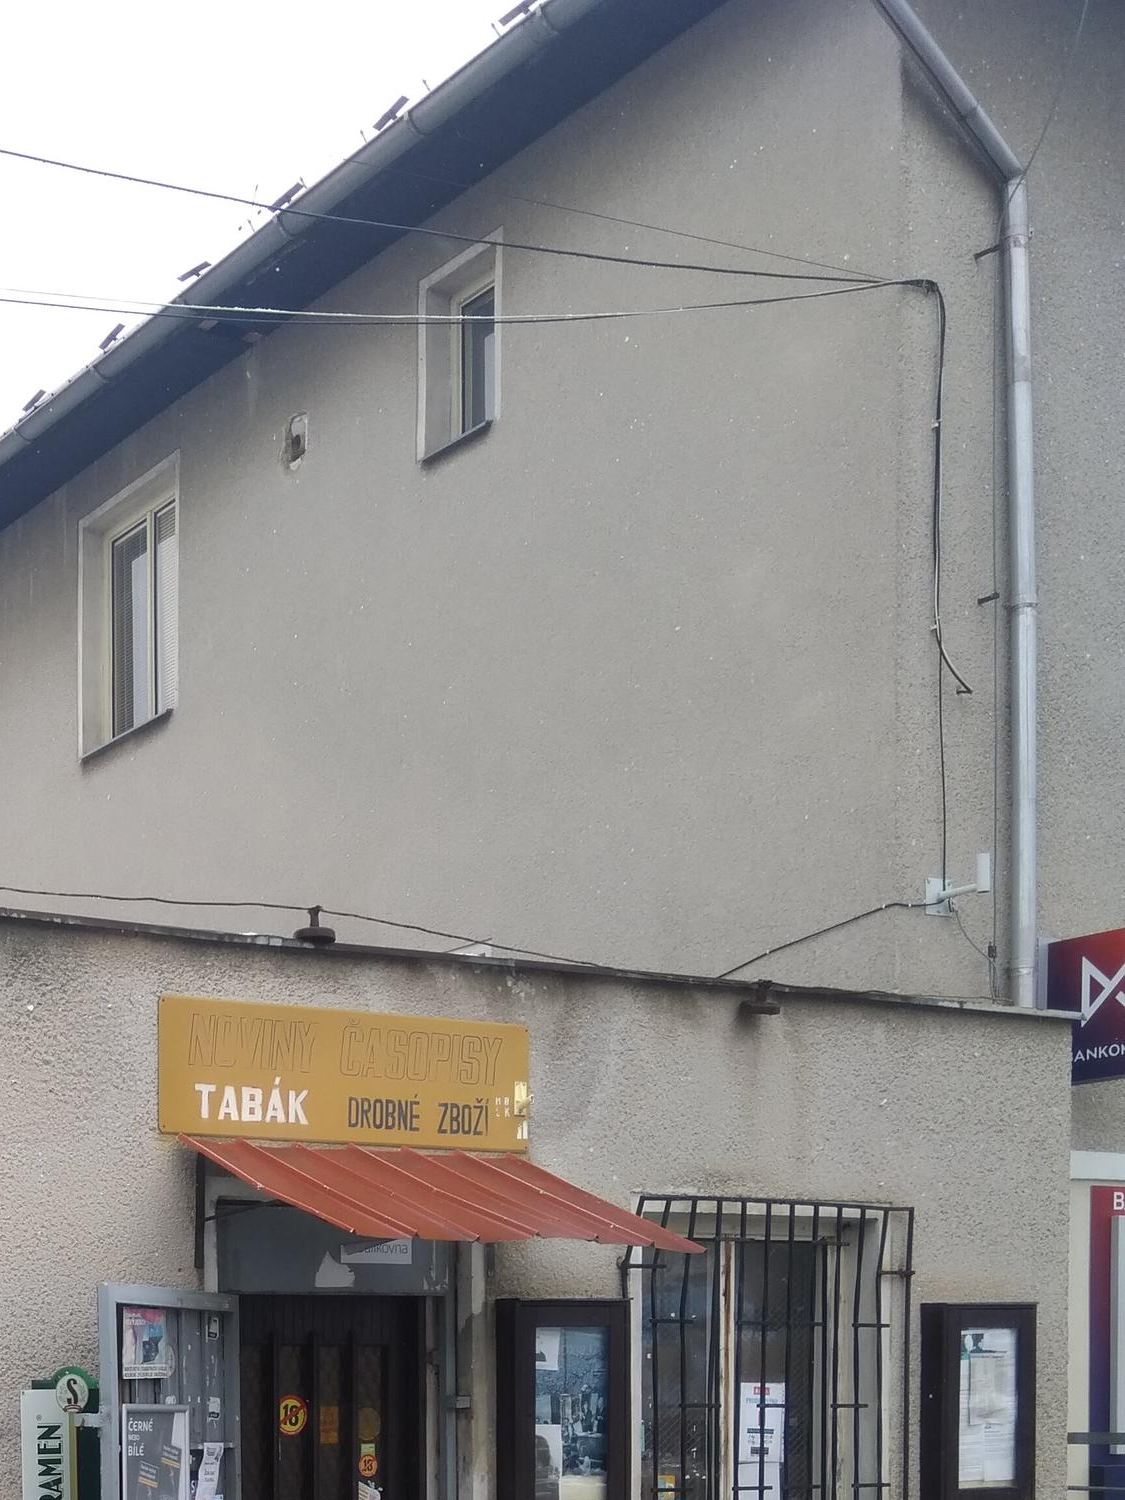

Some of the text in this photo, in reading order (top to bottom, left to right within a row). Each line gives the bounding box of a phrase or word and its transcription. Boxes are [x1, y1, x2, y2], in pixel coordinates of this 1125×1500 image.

[194, 1076, 309, 1126] TABÁK
[348, 1094, 420, 1133] DROBNÉ
[437, 1098, 489, 1137] ZBOŽÍ
[128, 1417, 154, 1432] ČERNÉ
[282, 1404, 300, 1427] 18
[127, 1442, 145, 1457] BÍLÉ
